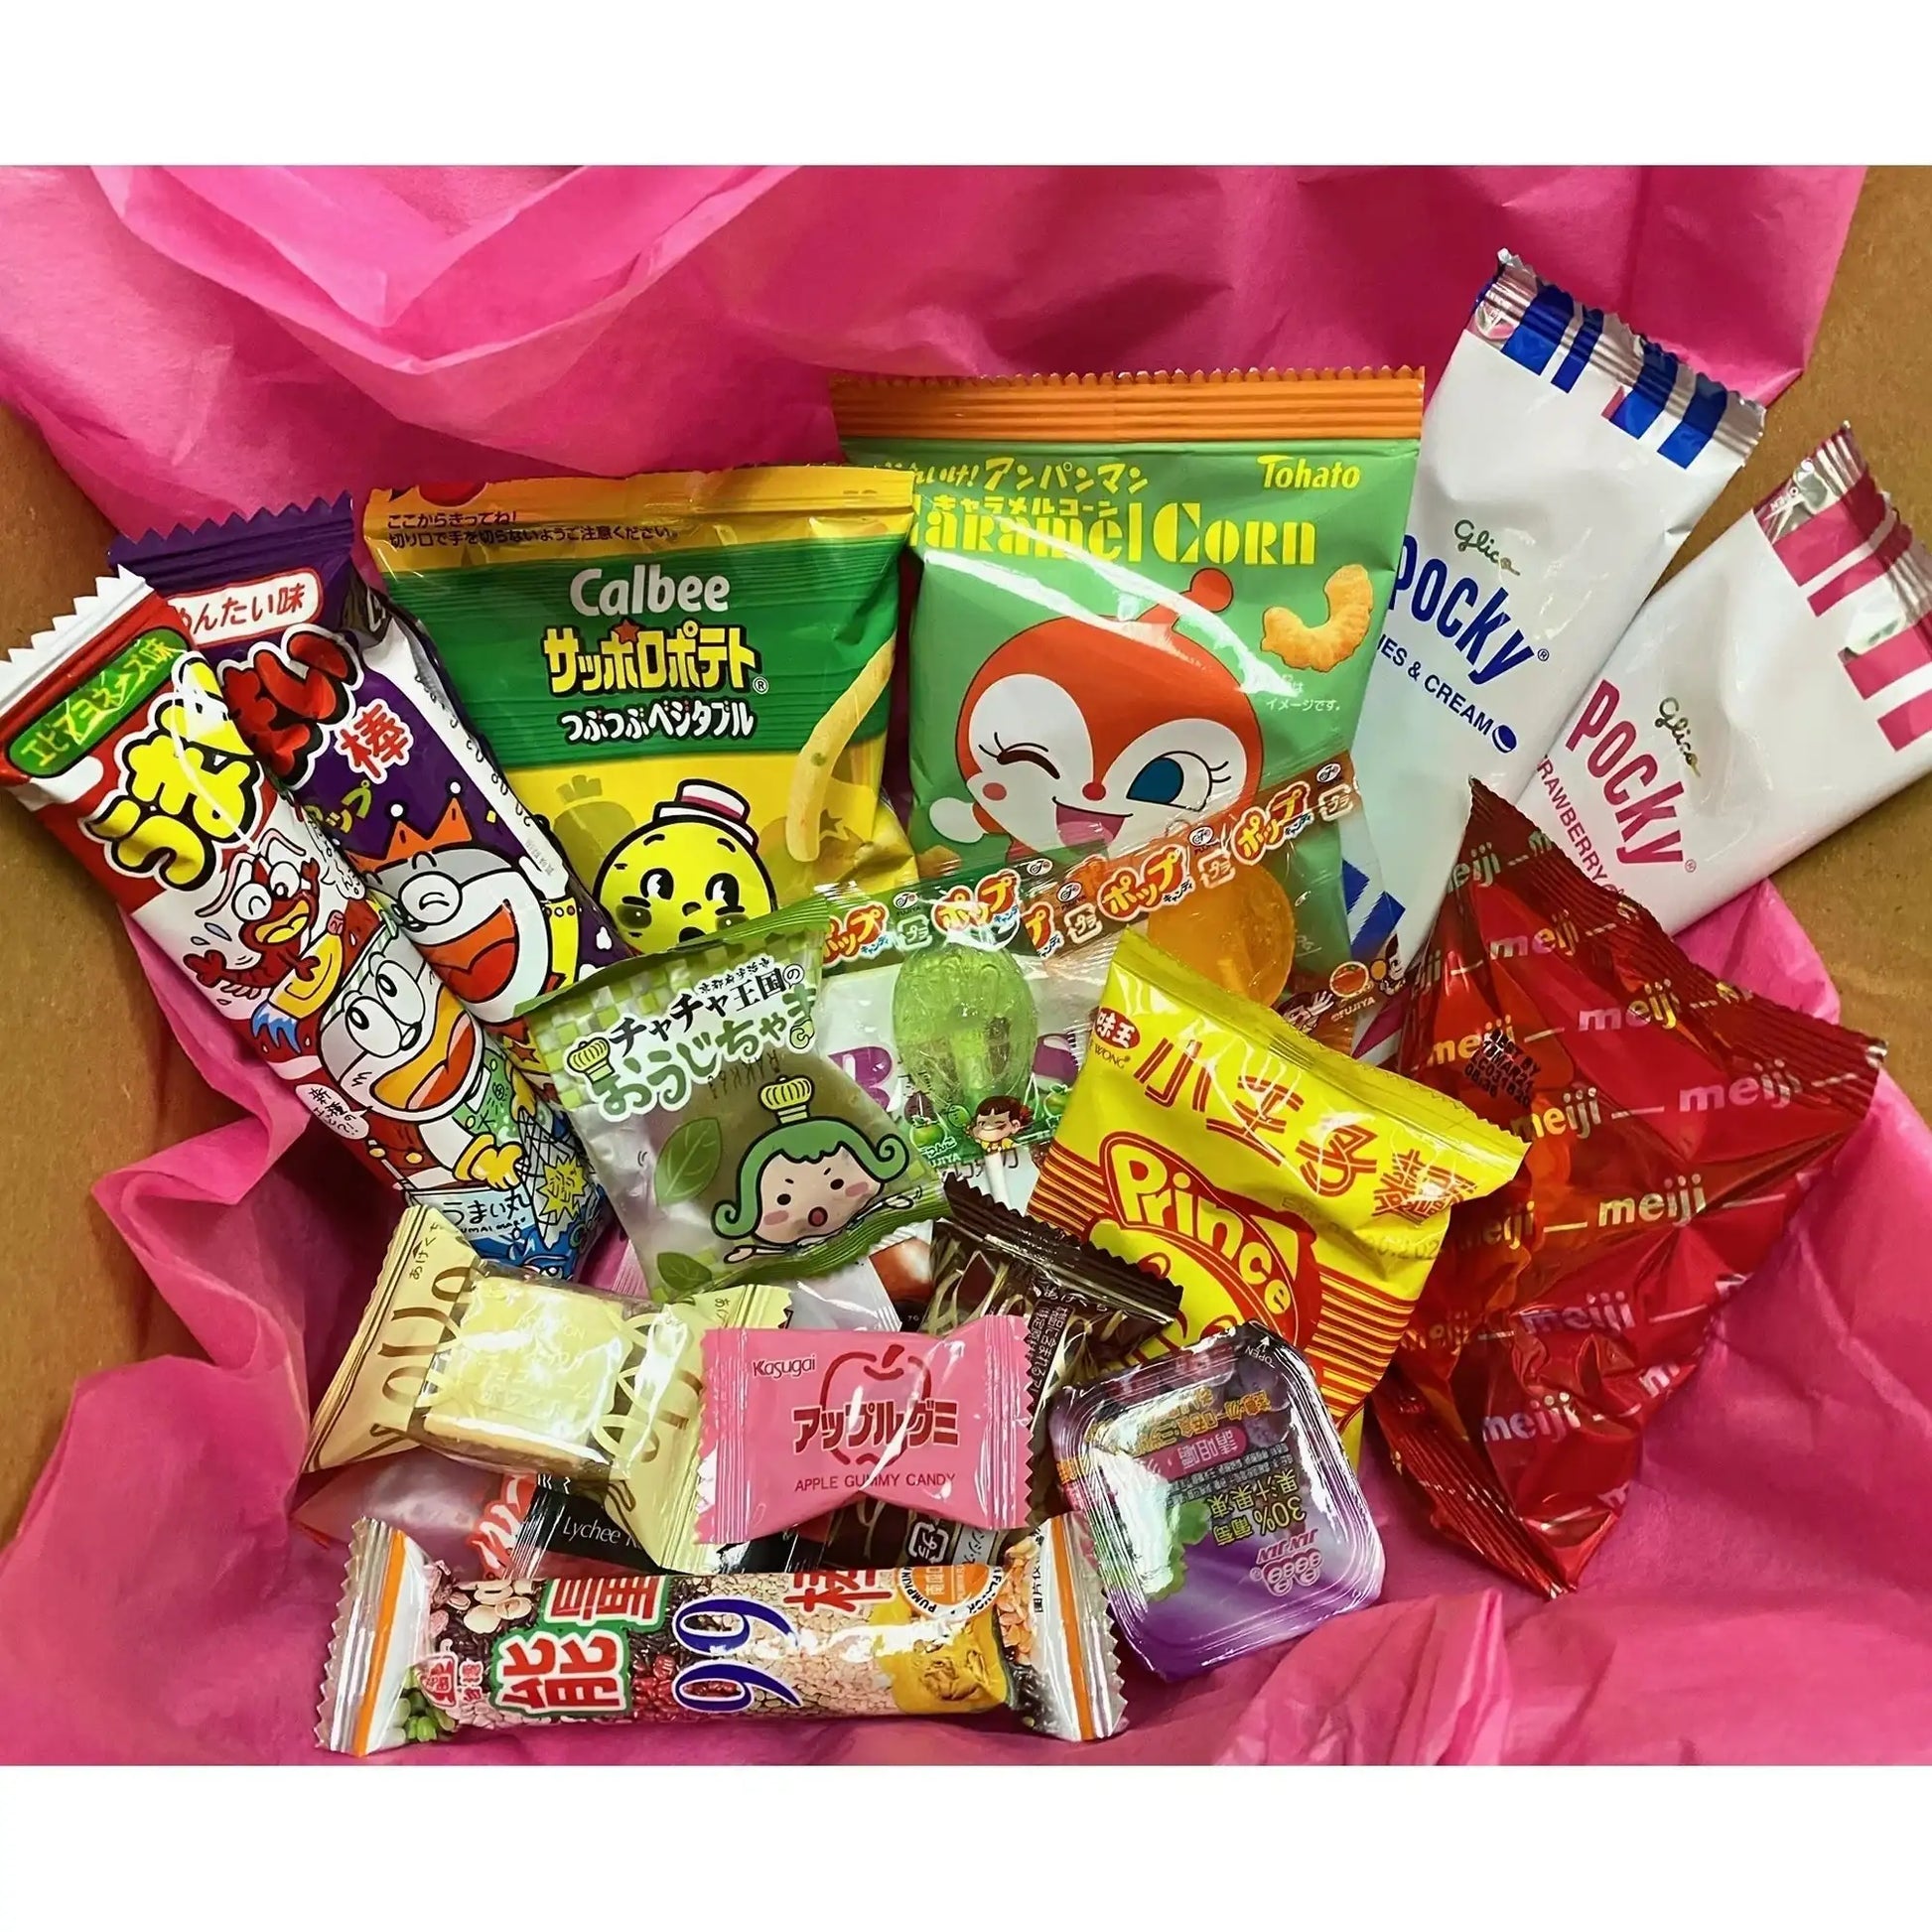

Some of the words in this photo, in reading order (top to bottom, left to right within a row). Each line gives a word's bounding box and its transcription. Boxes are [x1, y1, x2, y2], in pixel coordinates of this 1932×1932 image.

[1257, 455, 1360, 488] Tohato
[933, 495, 1118, 518] キャラメルコーン
[1454, 519, 1521, 576] Glico
[570, 564, 730, 617] Calbee
[543, 620, 757, 694] サッポロポテト
[561, 699, 755, 743] つぶつぶベジタブル
[1408, 661, 1423, 682] &
[1424, 675, 1494, 736] CREAM
[338, 703, 409, 779] 棒
[1238, 789, 1302, 857] ポップ
[1102, 851, 1179, 913] ポップ
[1095, 1011, 1136, 1049] 味王
[1598, 1173, 1707, 1228] meiji
[1110, 1144, 1292, 1315] Prince
[753, 1354, 816, 1378] Kasugai
[793, 1399, 959, 1454] アップルグミ
[795, 1476, 838, 1491] APPLE
[845, 1474, 899, 1489] GUMMY
[905, 1473, 956, 1486] CANDY
[563, 1516, 621, 1544] Lychee
[674, 1596, 802, 1713] 99
